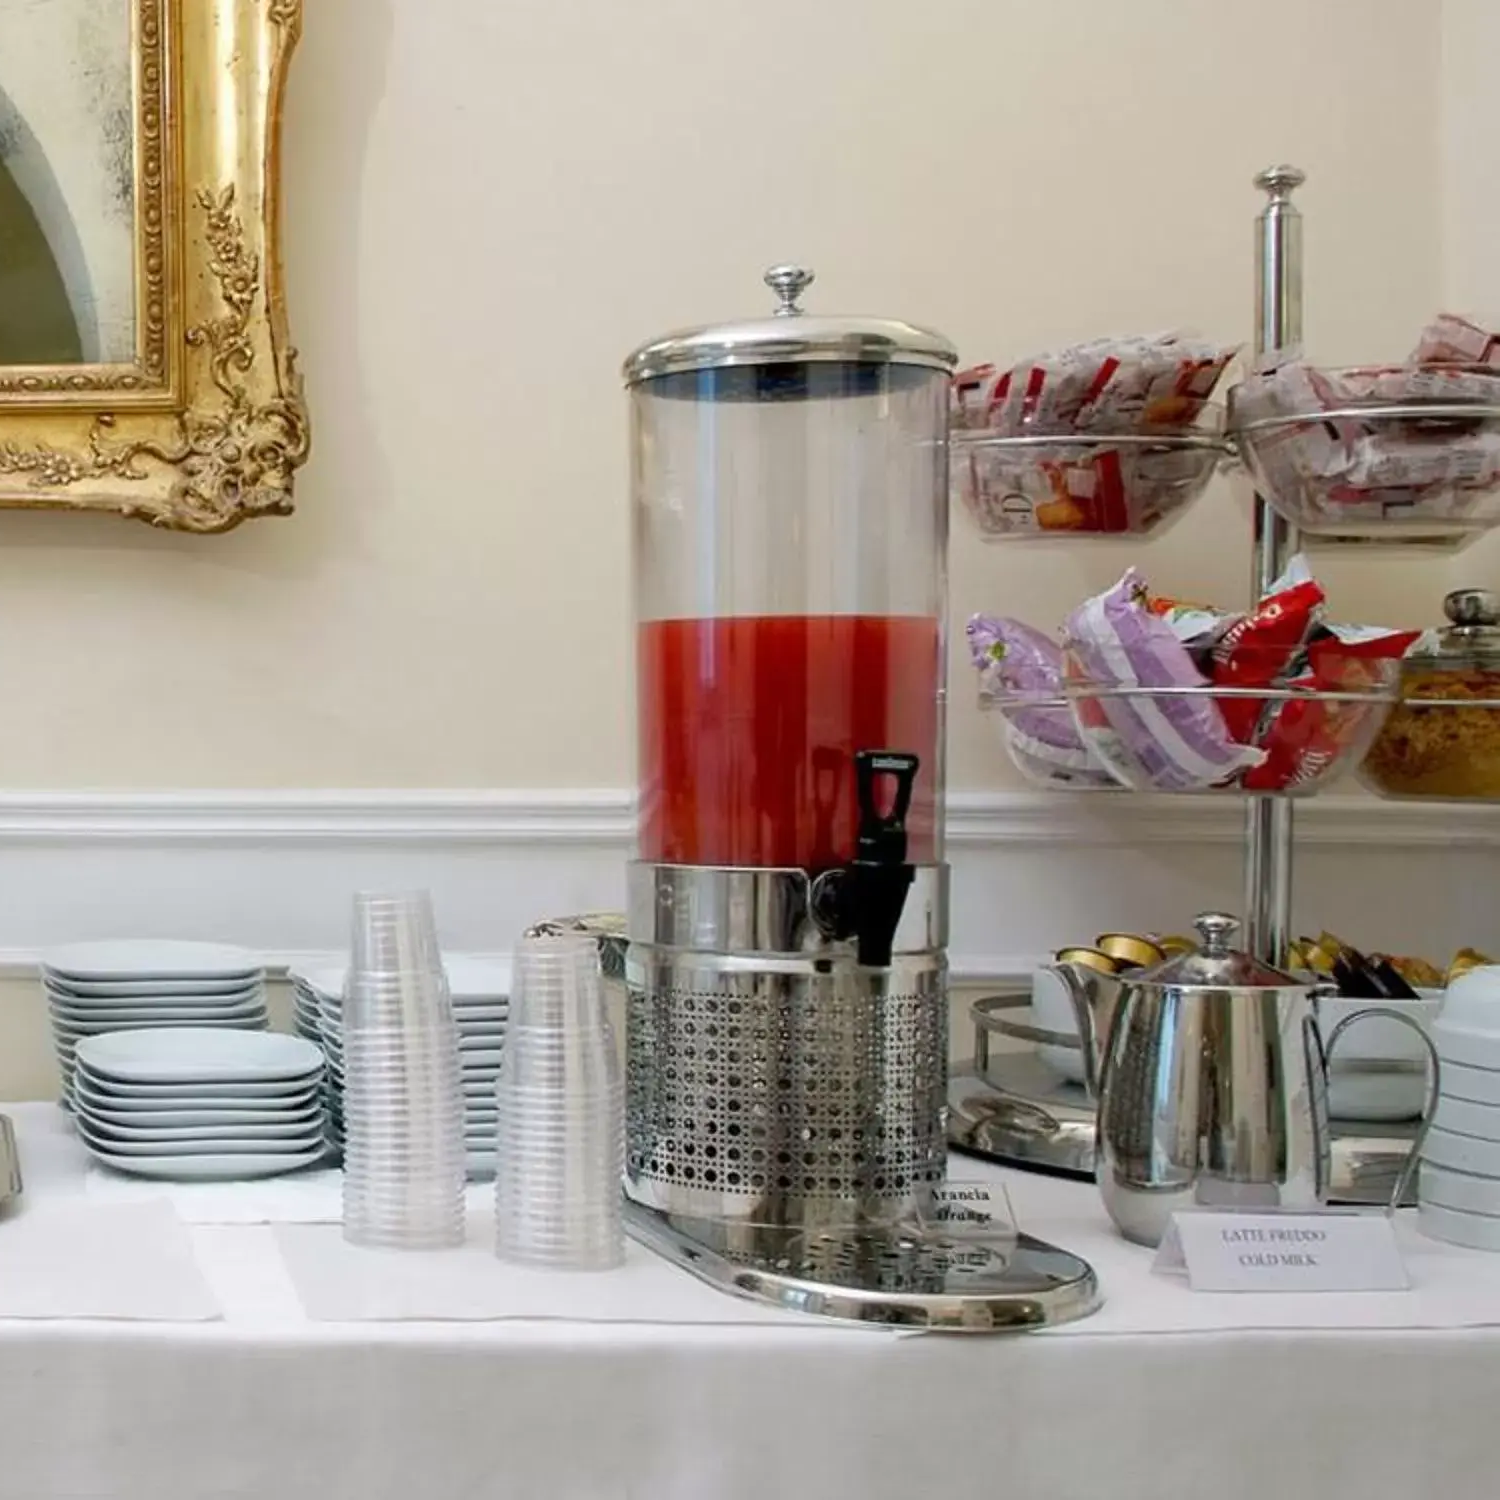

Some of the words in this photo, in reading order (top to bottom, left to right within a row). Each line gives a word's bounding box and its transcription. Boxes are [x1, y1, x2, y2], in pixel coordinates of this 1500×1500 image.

[1221, 1228, 1267, 1242] LATTE
[1238, 1253, 1279, 1267] COLD
[1280, 1253, 1317, 1267] MILK
